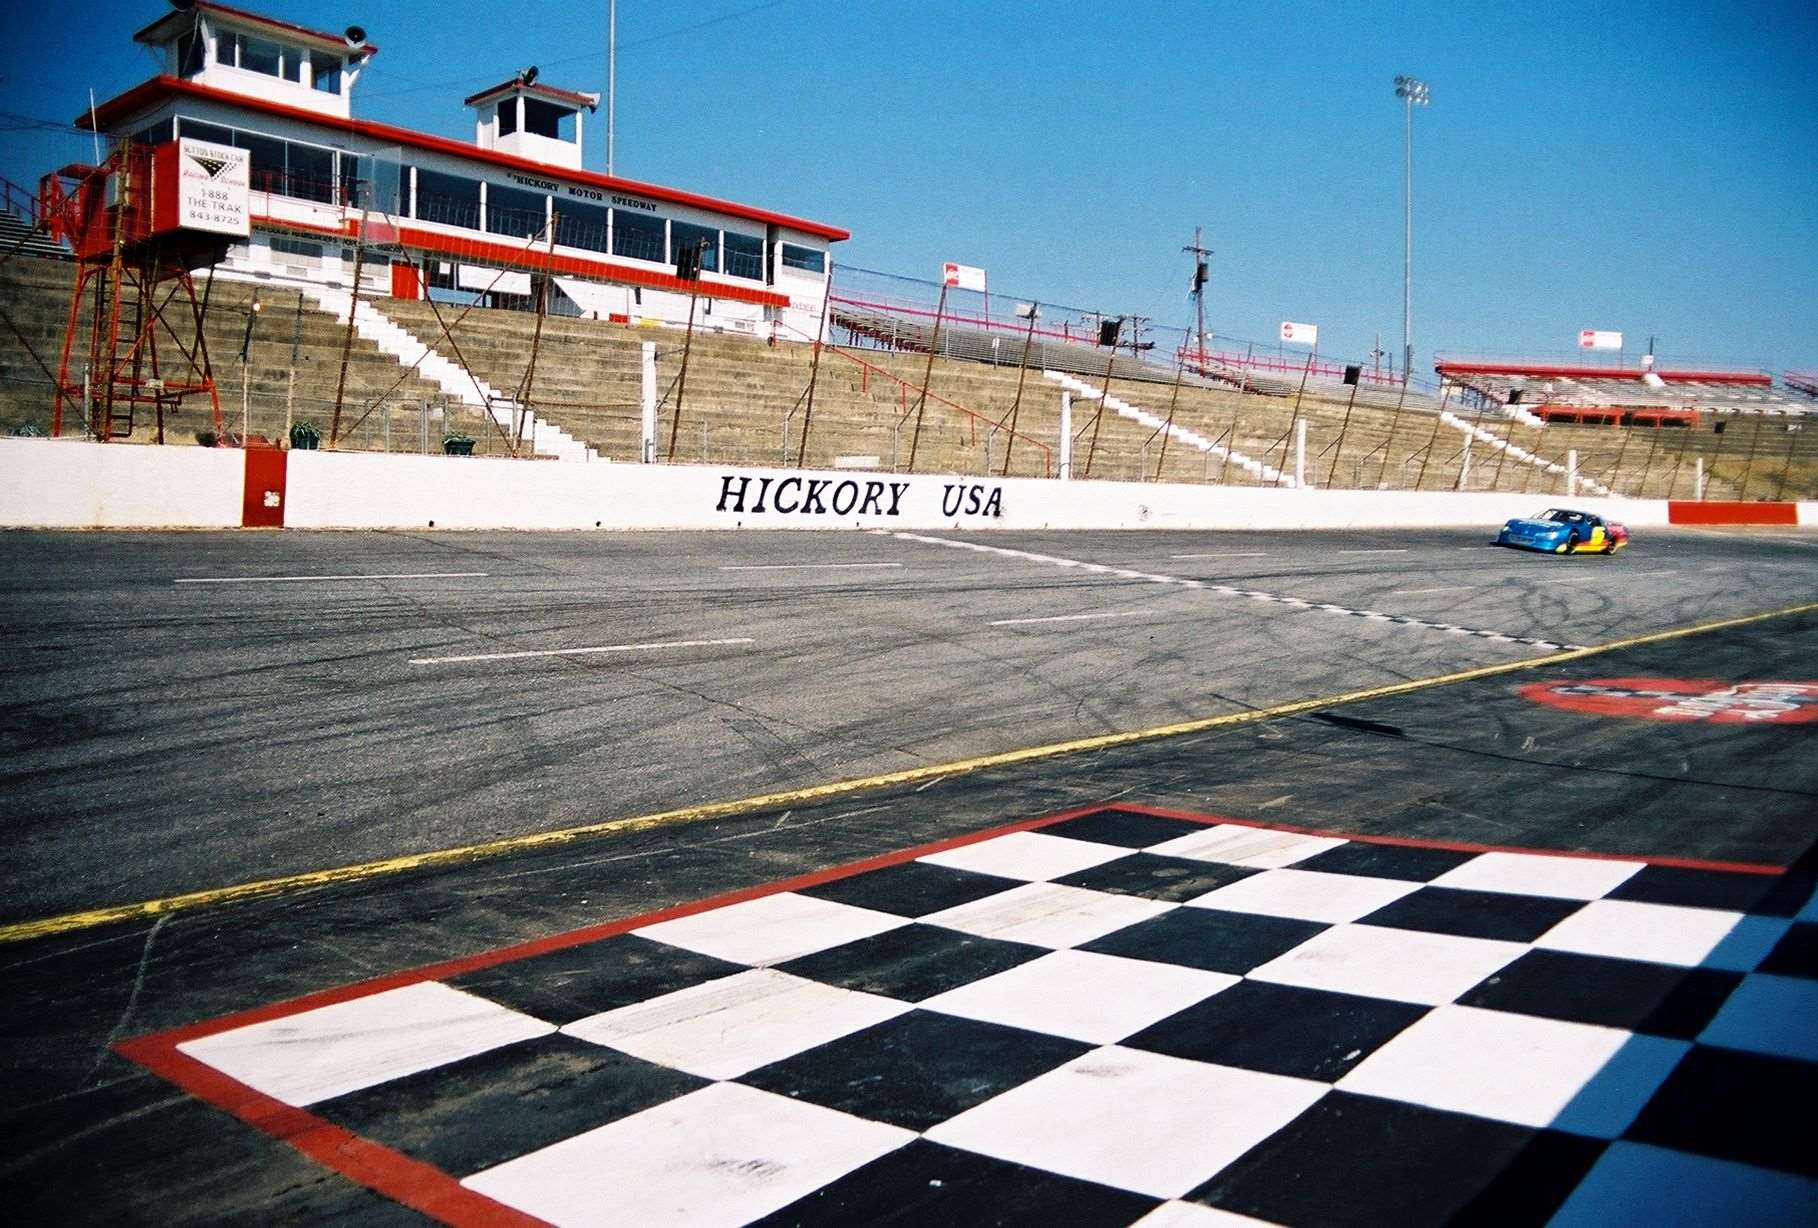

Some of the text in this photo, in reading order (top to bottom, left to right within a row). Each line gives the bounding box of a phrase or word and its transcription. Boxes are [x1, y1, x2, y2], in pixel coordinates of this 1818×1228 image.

[187, 197, 241, 213] THE TRAK
[568, 187, 603, 201] MOTOR
[611, 196, 657, 212] SPEEDWAY
[190, 210, 240, 225] 843-8725
[716, 476, 1003, 517] HICKORY USA
